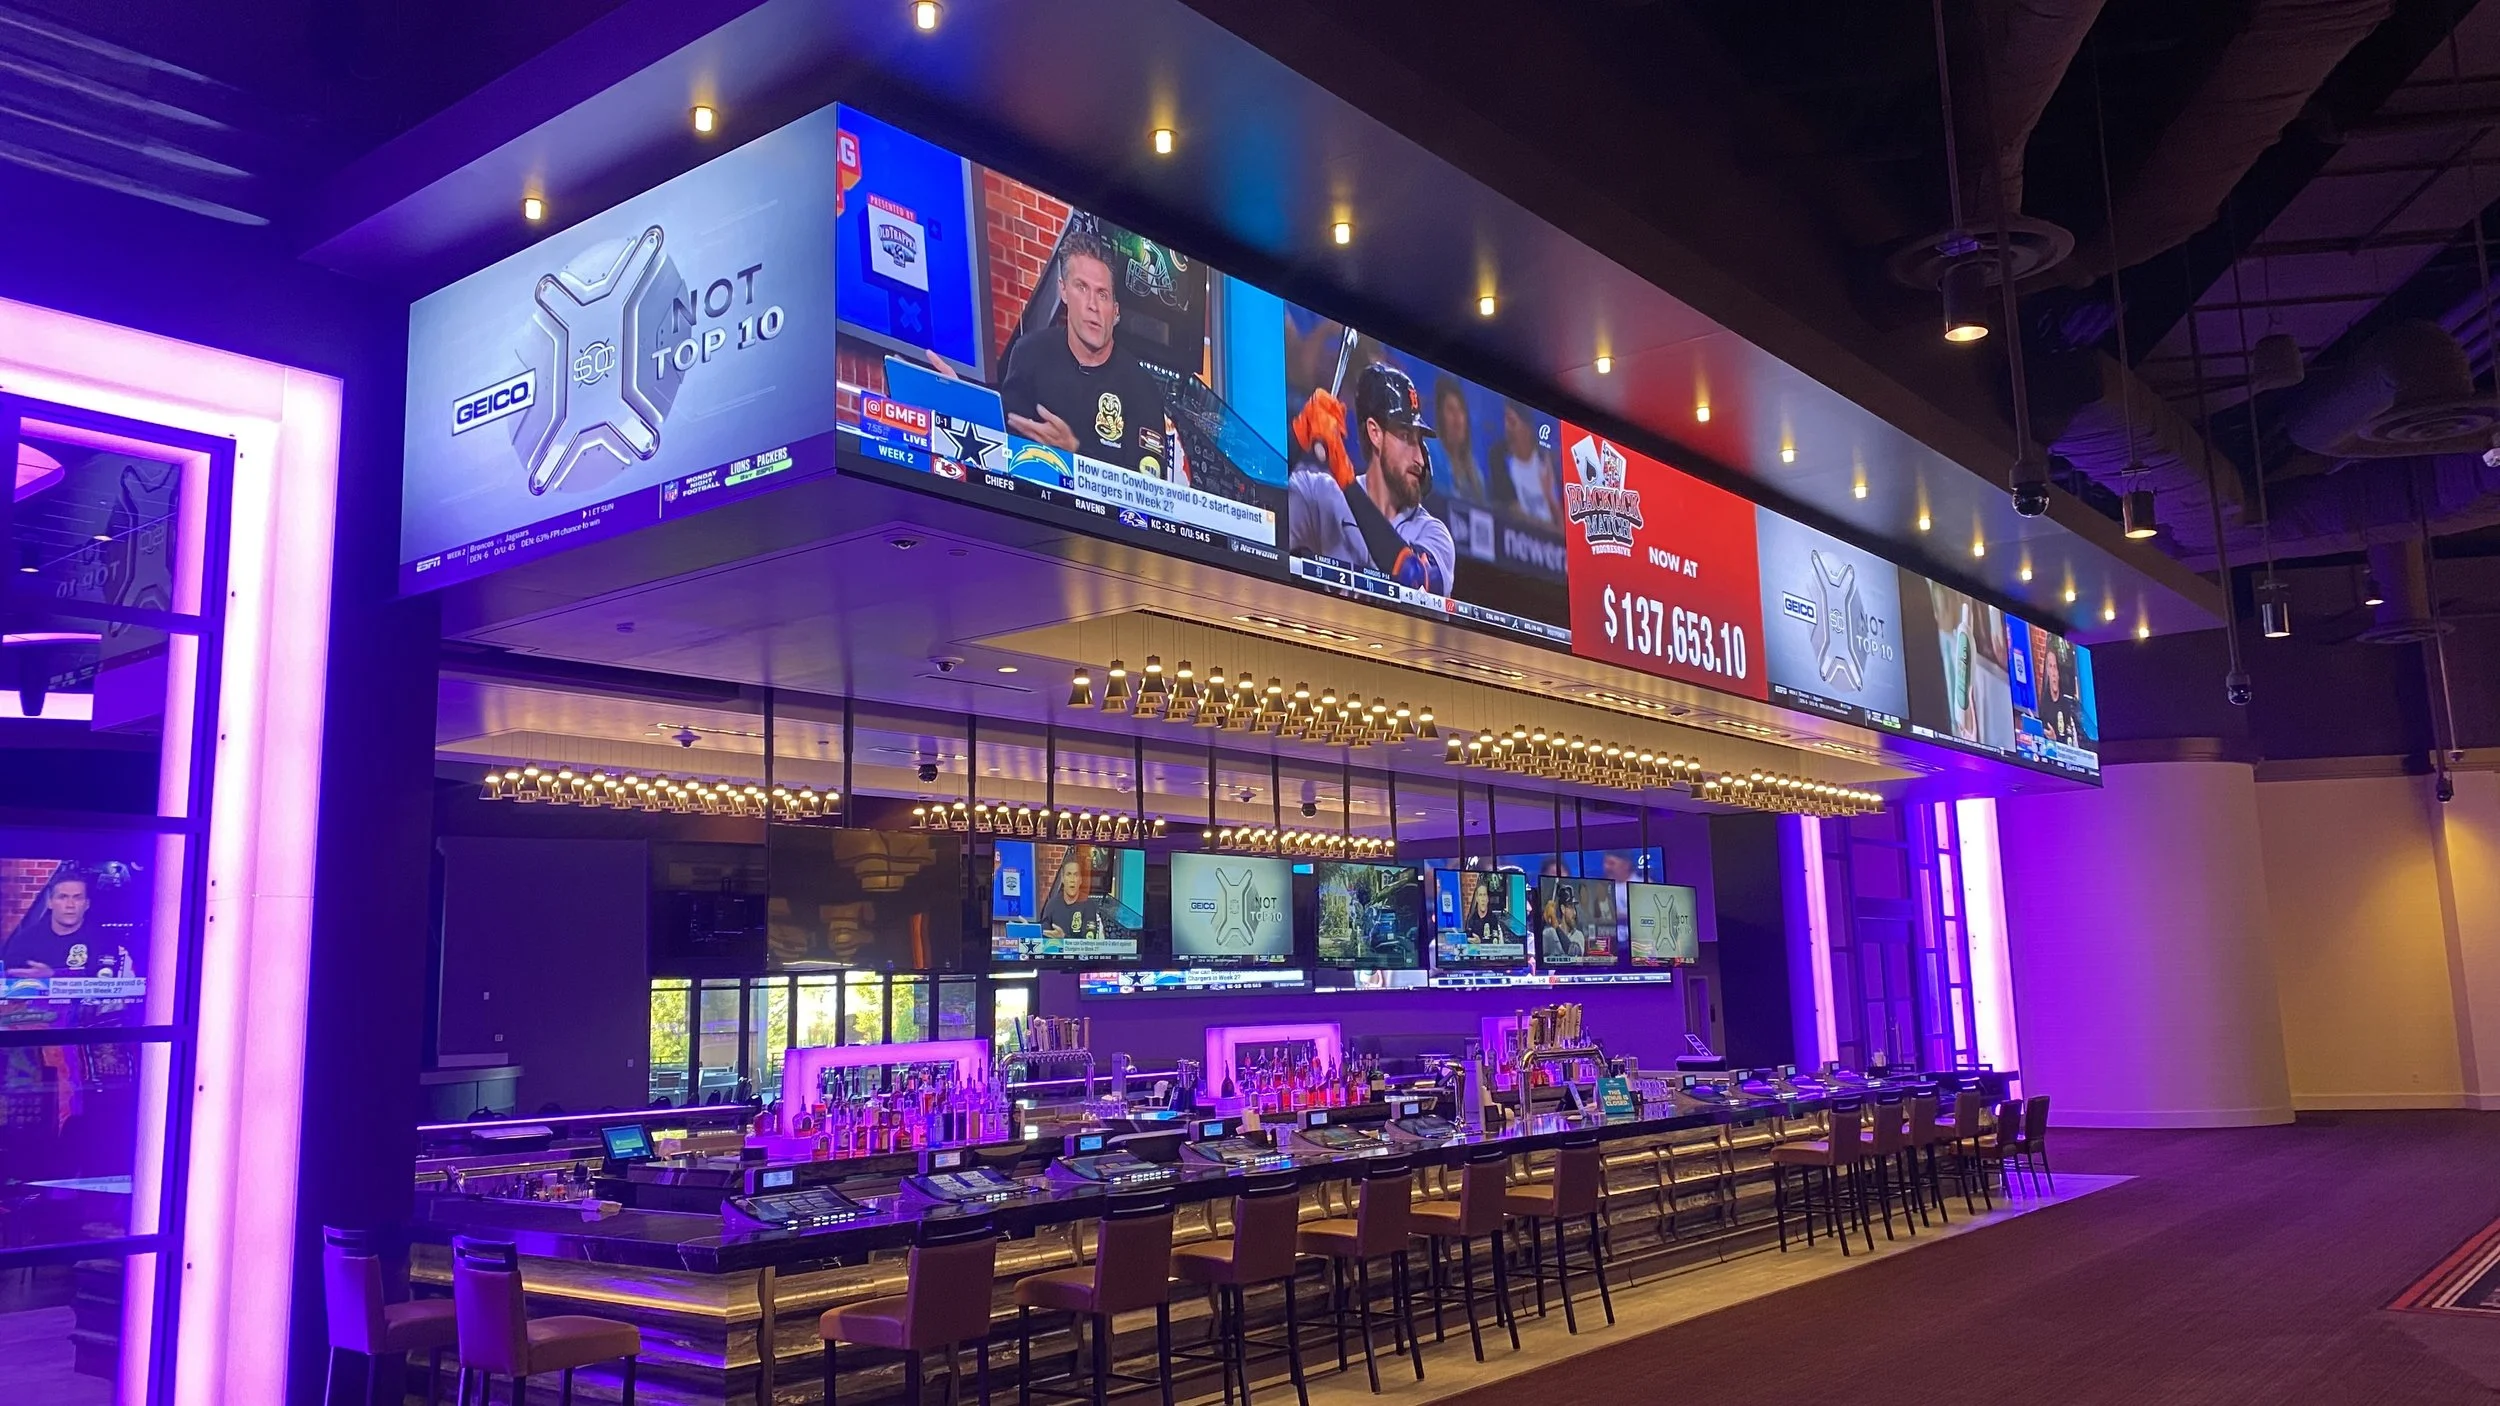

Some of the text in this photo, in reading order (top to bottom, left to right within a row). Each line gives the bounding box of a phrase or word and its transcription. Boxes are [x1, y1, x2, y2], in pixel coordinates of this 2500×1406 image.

[870, 194, 904, 217] PRESENTED
[672, 263, 762, 334] NOT
[651, 305, 785, 380] TOP 10
[456, 380, 529, 425] GEICO
[885, 404, 926, 428] GMFB
[935, 414, 947, 427] 0-1
[903, 433, 927, 447] LIVE
[730, 447, 788, 475] LIONS PACKERS
[878, 444, 914, 464] WEEK 2
[686, 470, 717, 484] MONDAY
[690, 477, 714, 489] NIGHT
[1062, 477, 1074, 488] 1-0
[683, 481, 721, 497] FOOTBALL
[1077, 458, 1262, 525] How can Cowboys avoid 0-2 start against
[1078, 476, 1175, 514] Chargers in Week 2?
[601, 503, 614, 513] SUN
[985, 474, 1014, 491] CHIEFS
[1040, 489, 1052, 500] AT
[1075, 498, 1106, 516] RAVENS
[1151, 518, 1161, 531] KC
[1162, 522, 1176, 534] -3.5
[1196, 531, 1211, 543] 54.5
[1568, 484, 1641, 521] BLACKJACK
[1585, 515, 1632, 541] MATCH
[470, 553, 482, 564] DEN
[508, 543, 516, 552] 45
[521, 538, 535, 548] DEN:
[536, 534, 549, 544] 63%
[550, 528, 560, 540] FPI
[560, 524, 582, 536] chance
[582, 521, 589, 530] to
[589, 518, 600, 528] win
[470, 540, 494, 554] Broncos
[505, 529, 529, 544] Jaguars
[1239, 544, 1279, 561] NETWORK
[1591, 545, 1632, 557] PROGRESSIVE
[1649, 546, 1698, 578] NOW AT
[1339, 573, 1346, 584] 2
[1388, 585, 1395, 596] 5
[1408, 592, 1413, 600] 9
[1433, 598, 1442, 608] 1-0
[1784, 598, 1815, 619] GEICO
[1604, 584, 1747, 680] $137,653.10
[1860, 612, 1885, 639] NOT
[1856, 635, 1893, 662] TOP 10
[1191, 902, 1215, 910] GEICO
[1255, 897, 1277, 909] NOT
